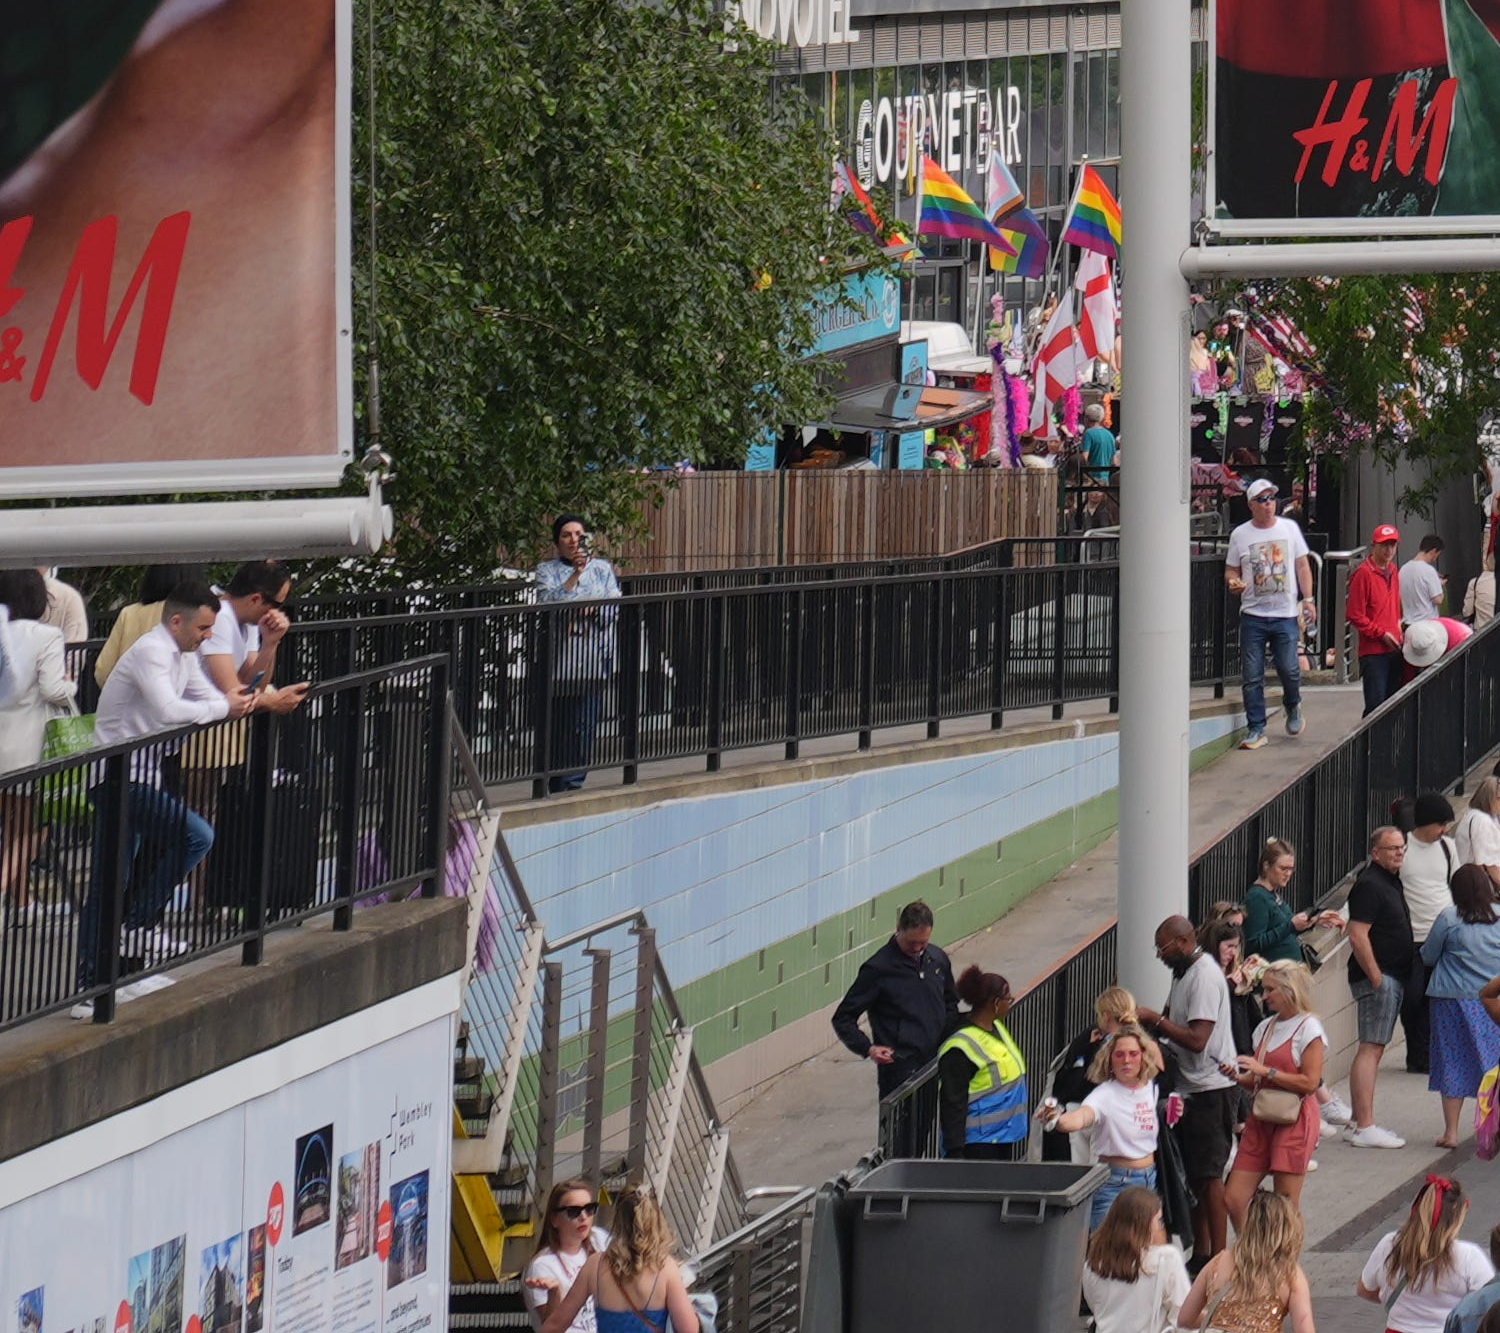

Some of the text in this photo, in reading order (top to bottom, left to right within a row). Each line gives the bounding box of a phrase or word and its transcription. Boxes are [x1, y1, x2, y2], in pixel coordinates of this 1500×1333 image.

[1292, 77, 1458, 188] H&M
[399, 1101, 432, 1126] Wembley
[397, 1134, 415, 1153] Park
